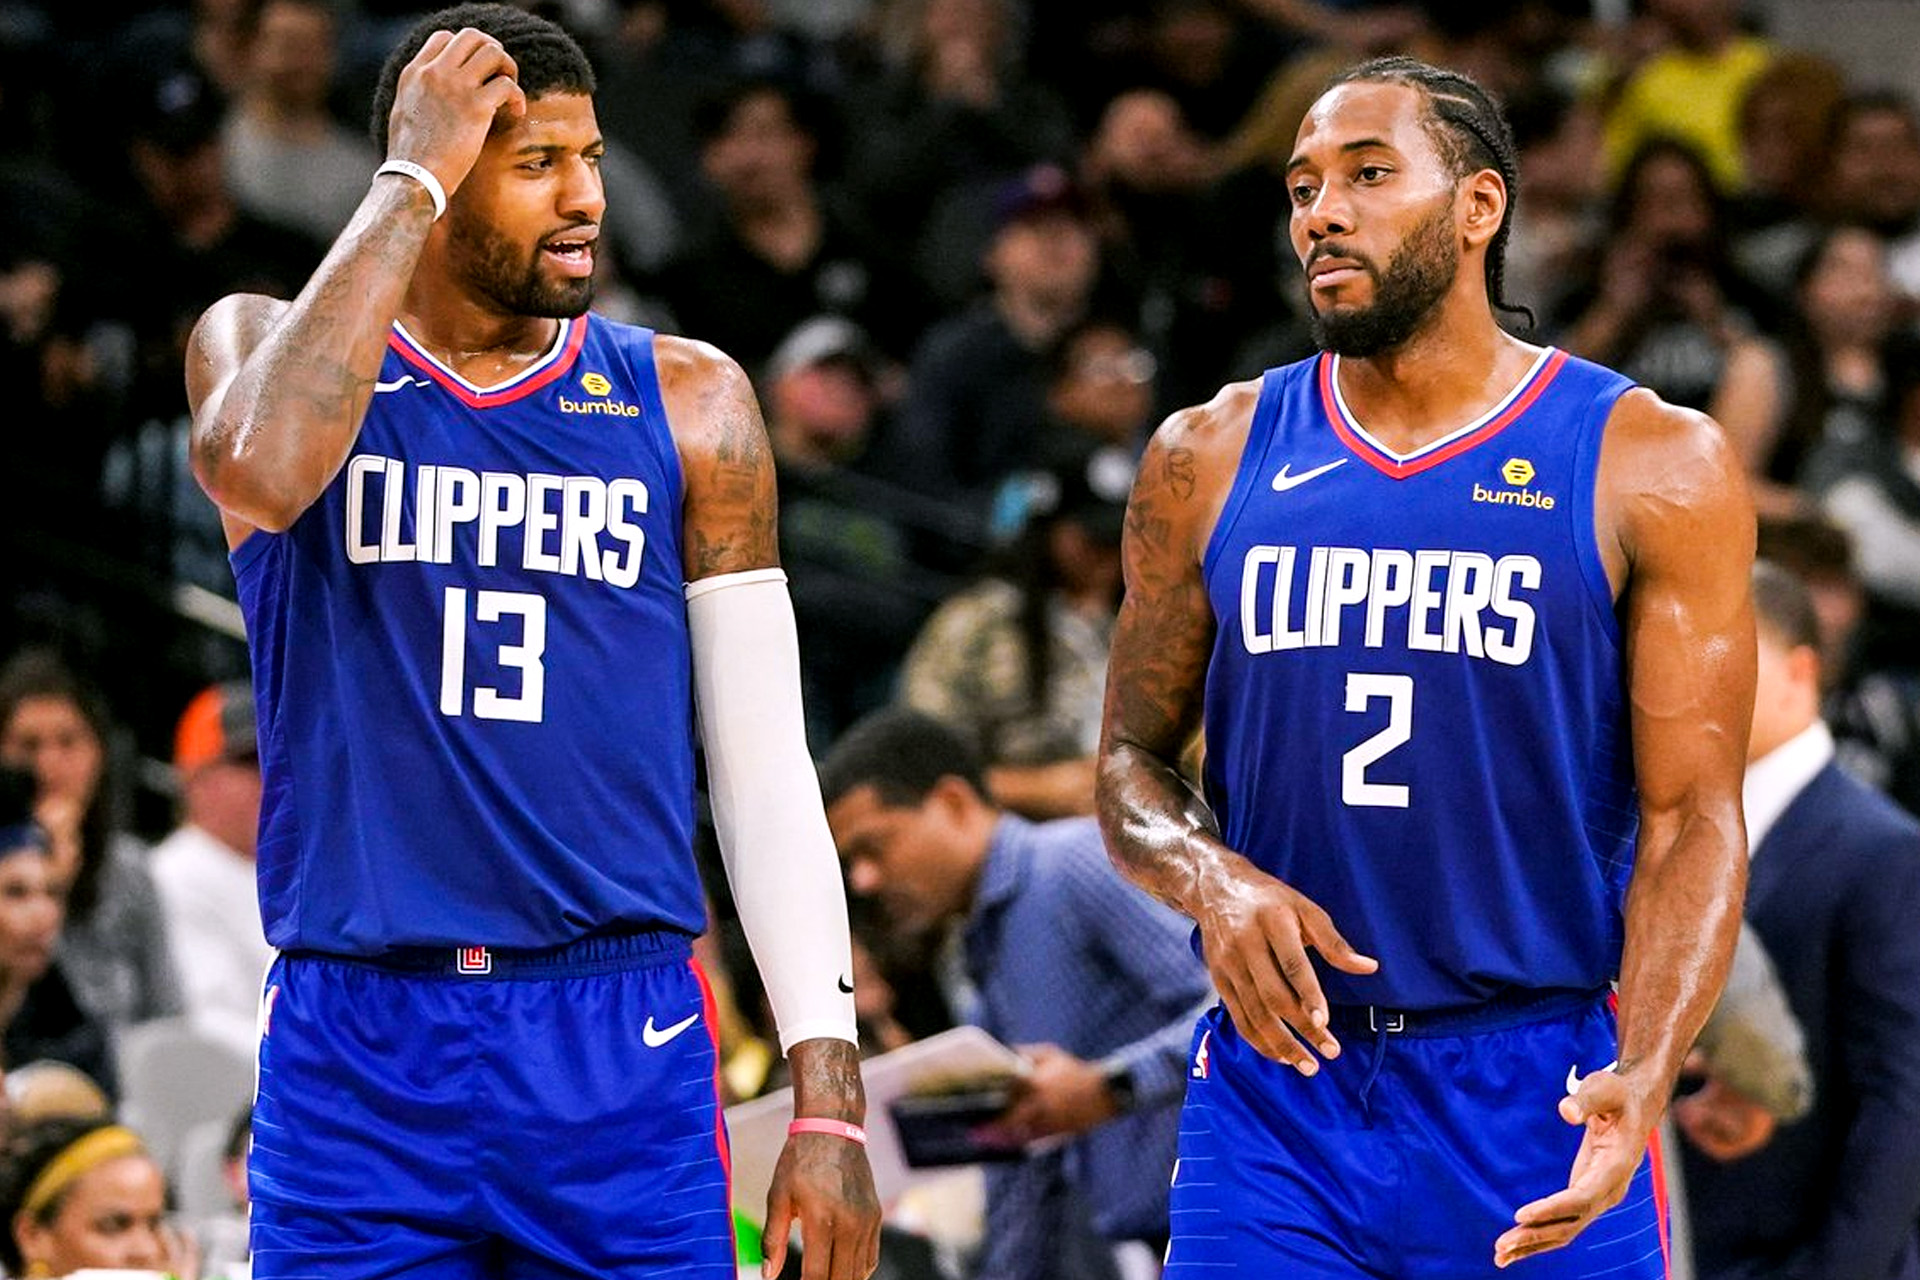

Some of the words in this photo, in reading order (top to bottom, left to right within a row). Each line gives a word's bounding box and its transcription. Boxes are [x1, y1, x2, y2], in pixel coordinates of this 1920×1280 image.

[559, 395, 640, 417] bumble
[346, 454, 649, 589] CLIPPERS
[1472, 483, 1555, 510] bumble
[440, 586, 546, 723] 13
[1240, 545, 1542, 666] CLIPPERS
[1342, 672, 1414, 808] 2
